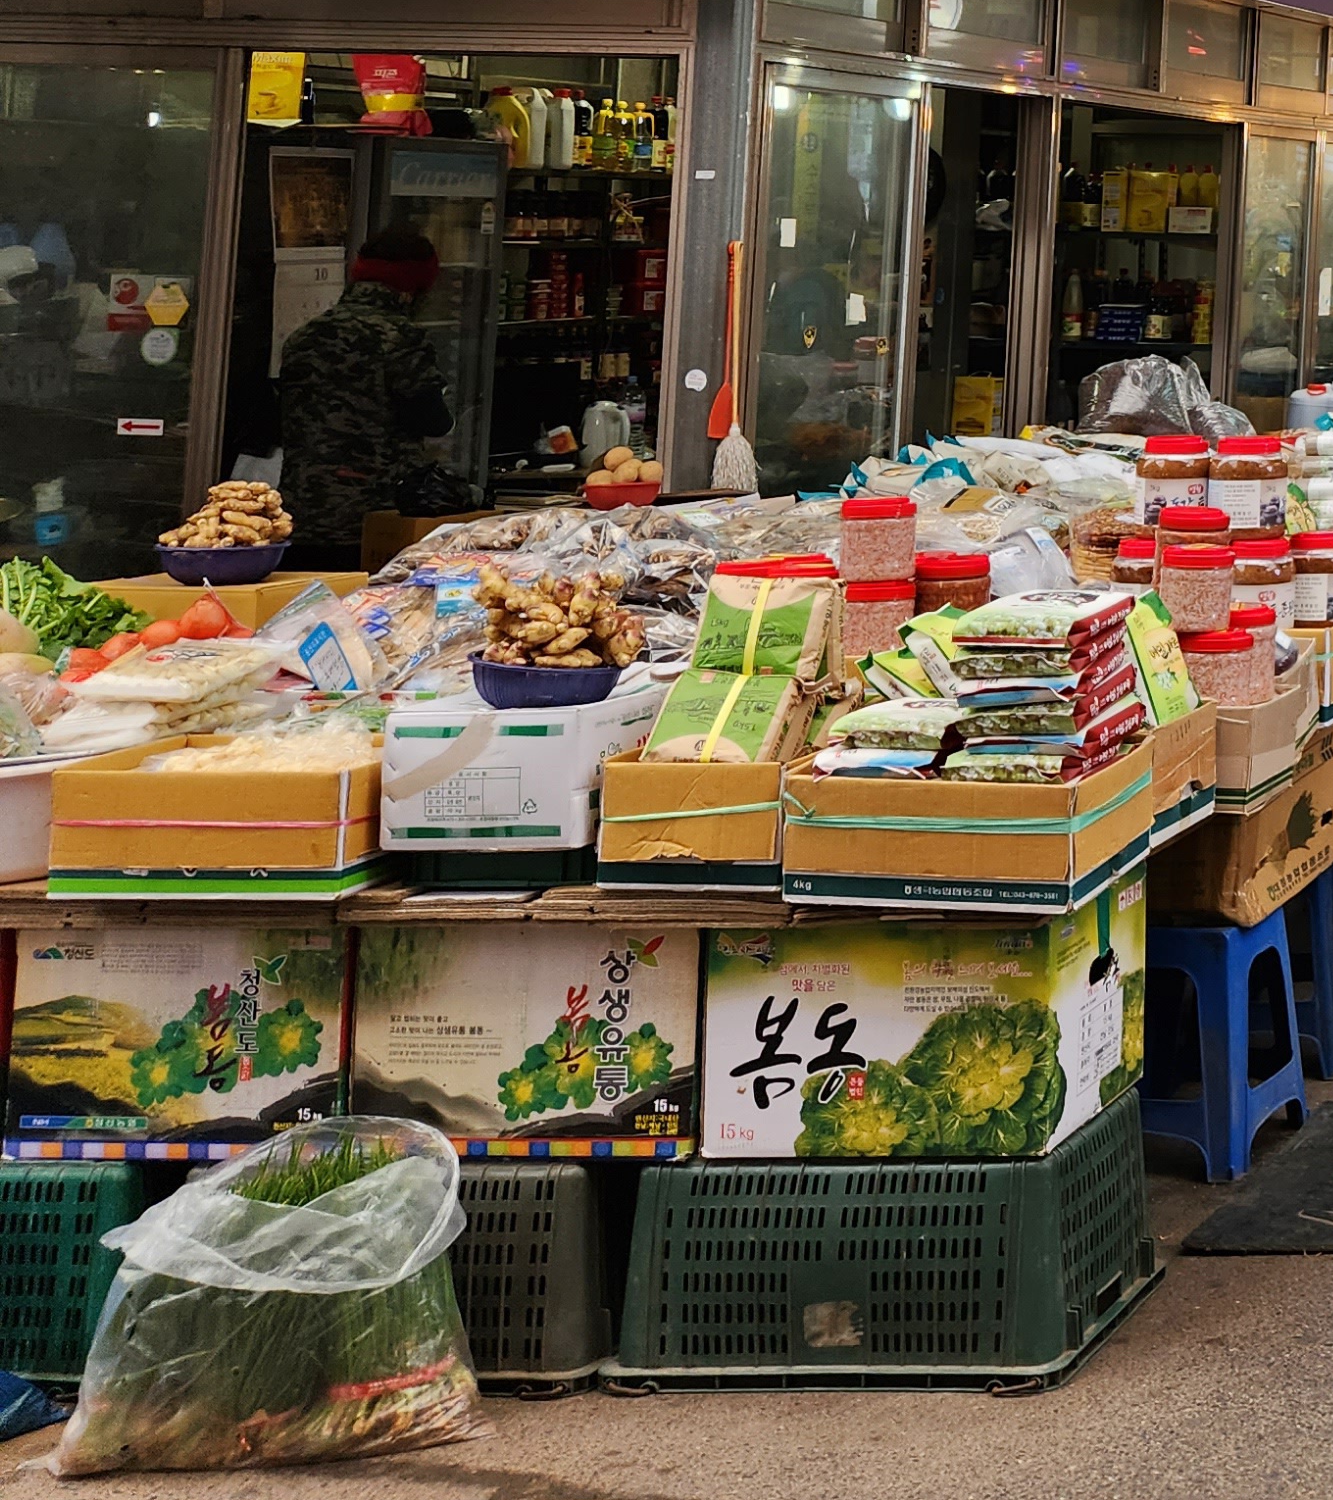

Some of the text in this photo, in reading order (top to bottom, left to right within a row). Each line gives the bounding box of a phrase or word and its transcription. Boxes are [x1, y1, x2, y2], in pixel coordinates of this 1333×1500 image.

[792, 879, 812, 891] 4kg
[233, 967, 262, 1055] 청산도
[593, 950, 638, 1104] 상생유통
[729, 995, 868, 1111] 봄동
[297, 1107, 312, 1121] 15
[653, 1099, 668, 1113] 15
[719, 1122, 755, 1141] 15 kg
